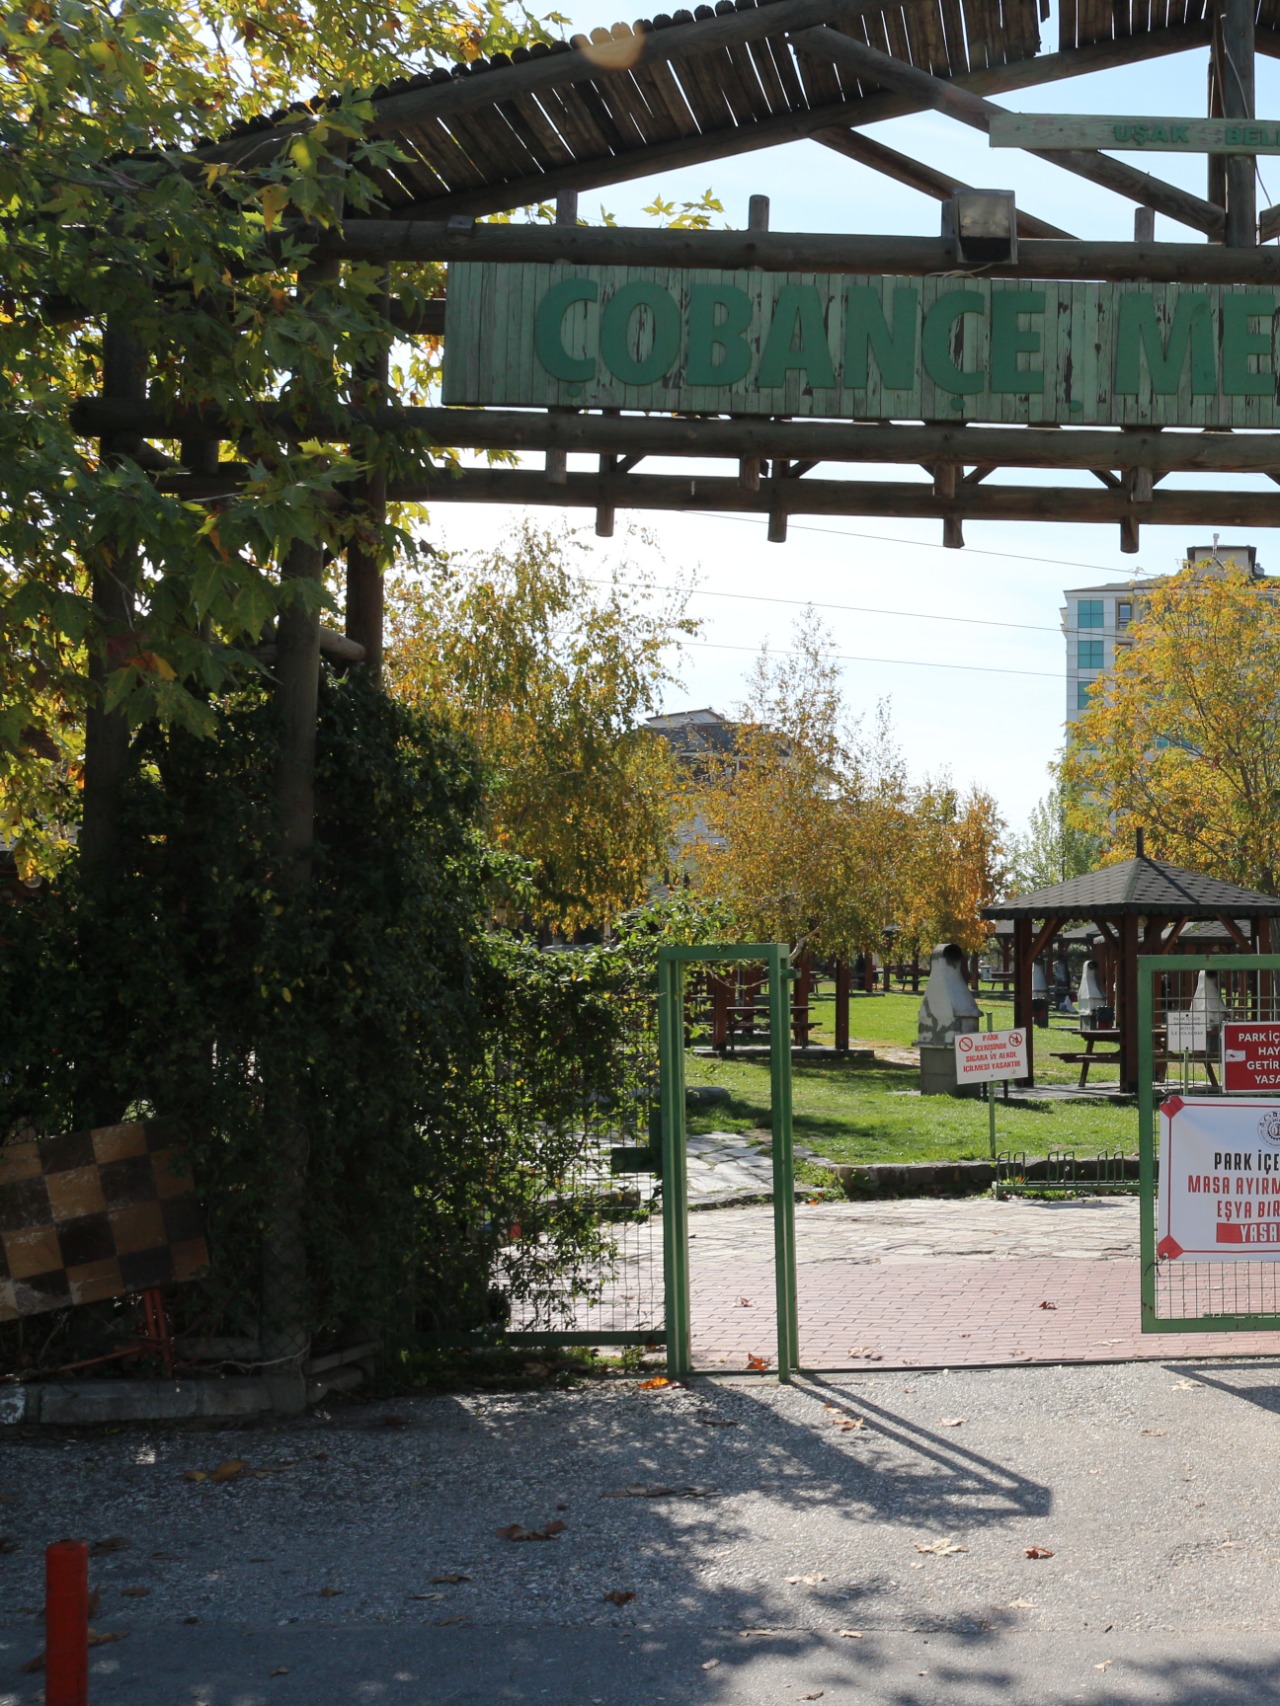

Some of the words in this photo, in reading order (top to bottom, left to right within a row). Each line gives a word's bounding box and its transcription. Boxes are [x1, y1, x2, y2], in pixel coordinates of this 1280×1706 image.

[1238, 1033, 1267, 1043] PARK
[1214, 1152, 1252, 1171] PARK
[1187, 1175, 1230, 1194] MASA
[1217, 1200, 1252, 1221] EŞYA
